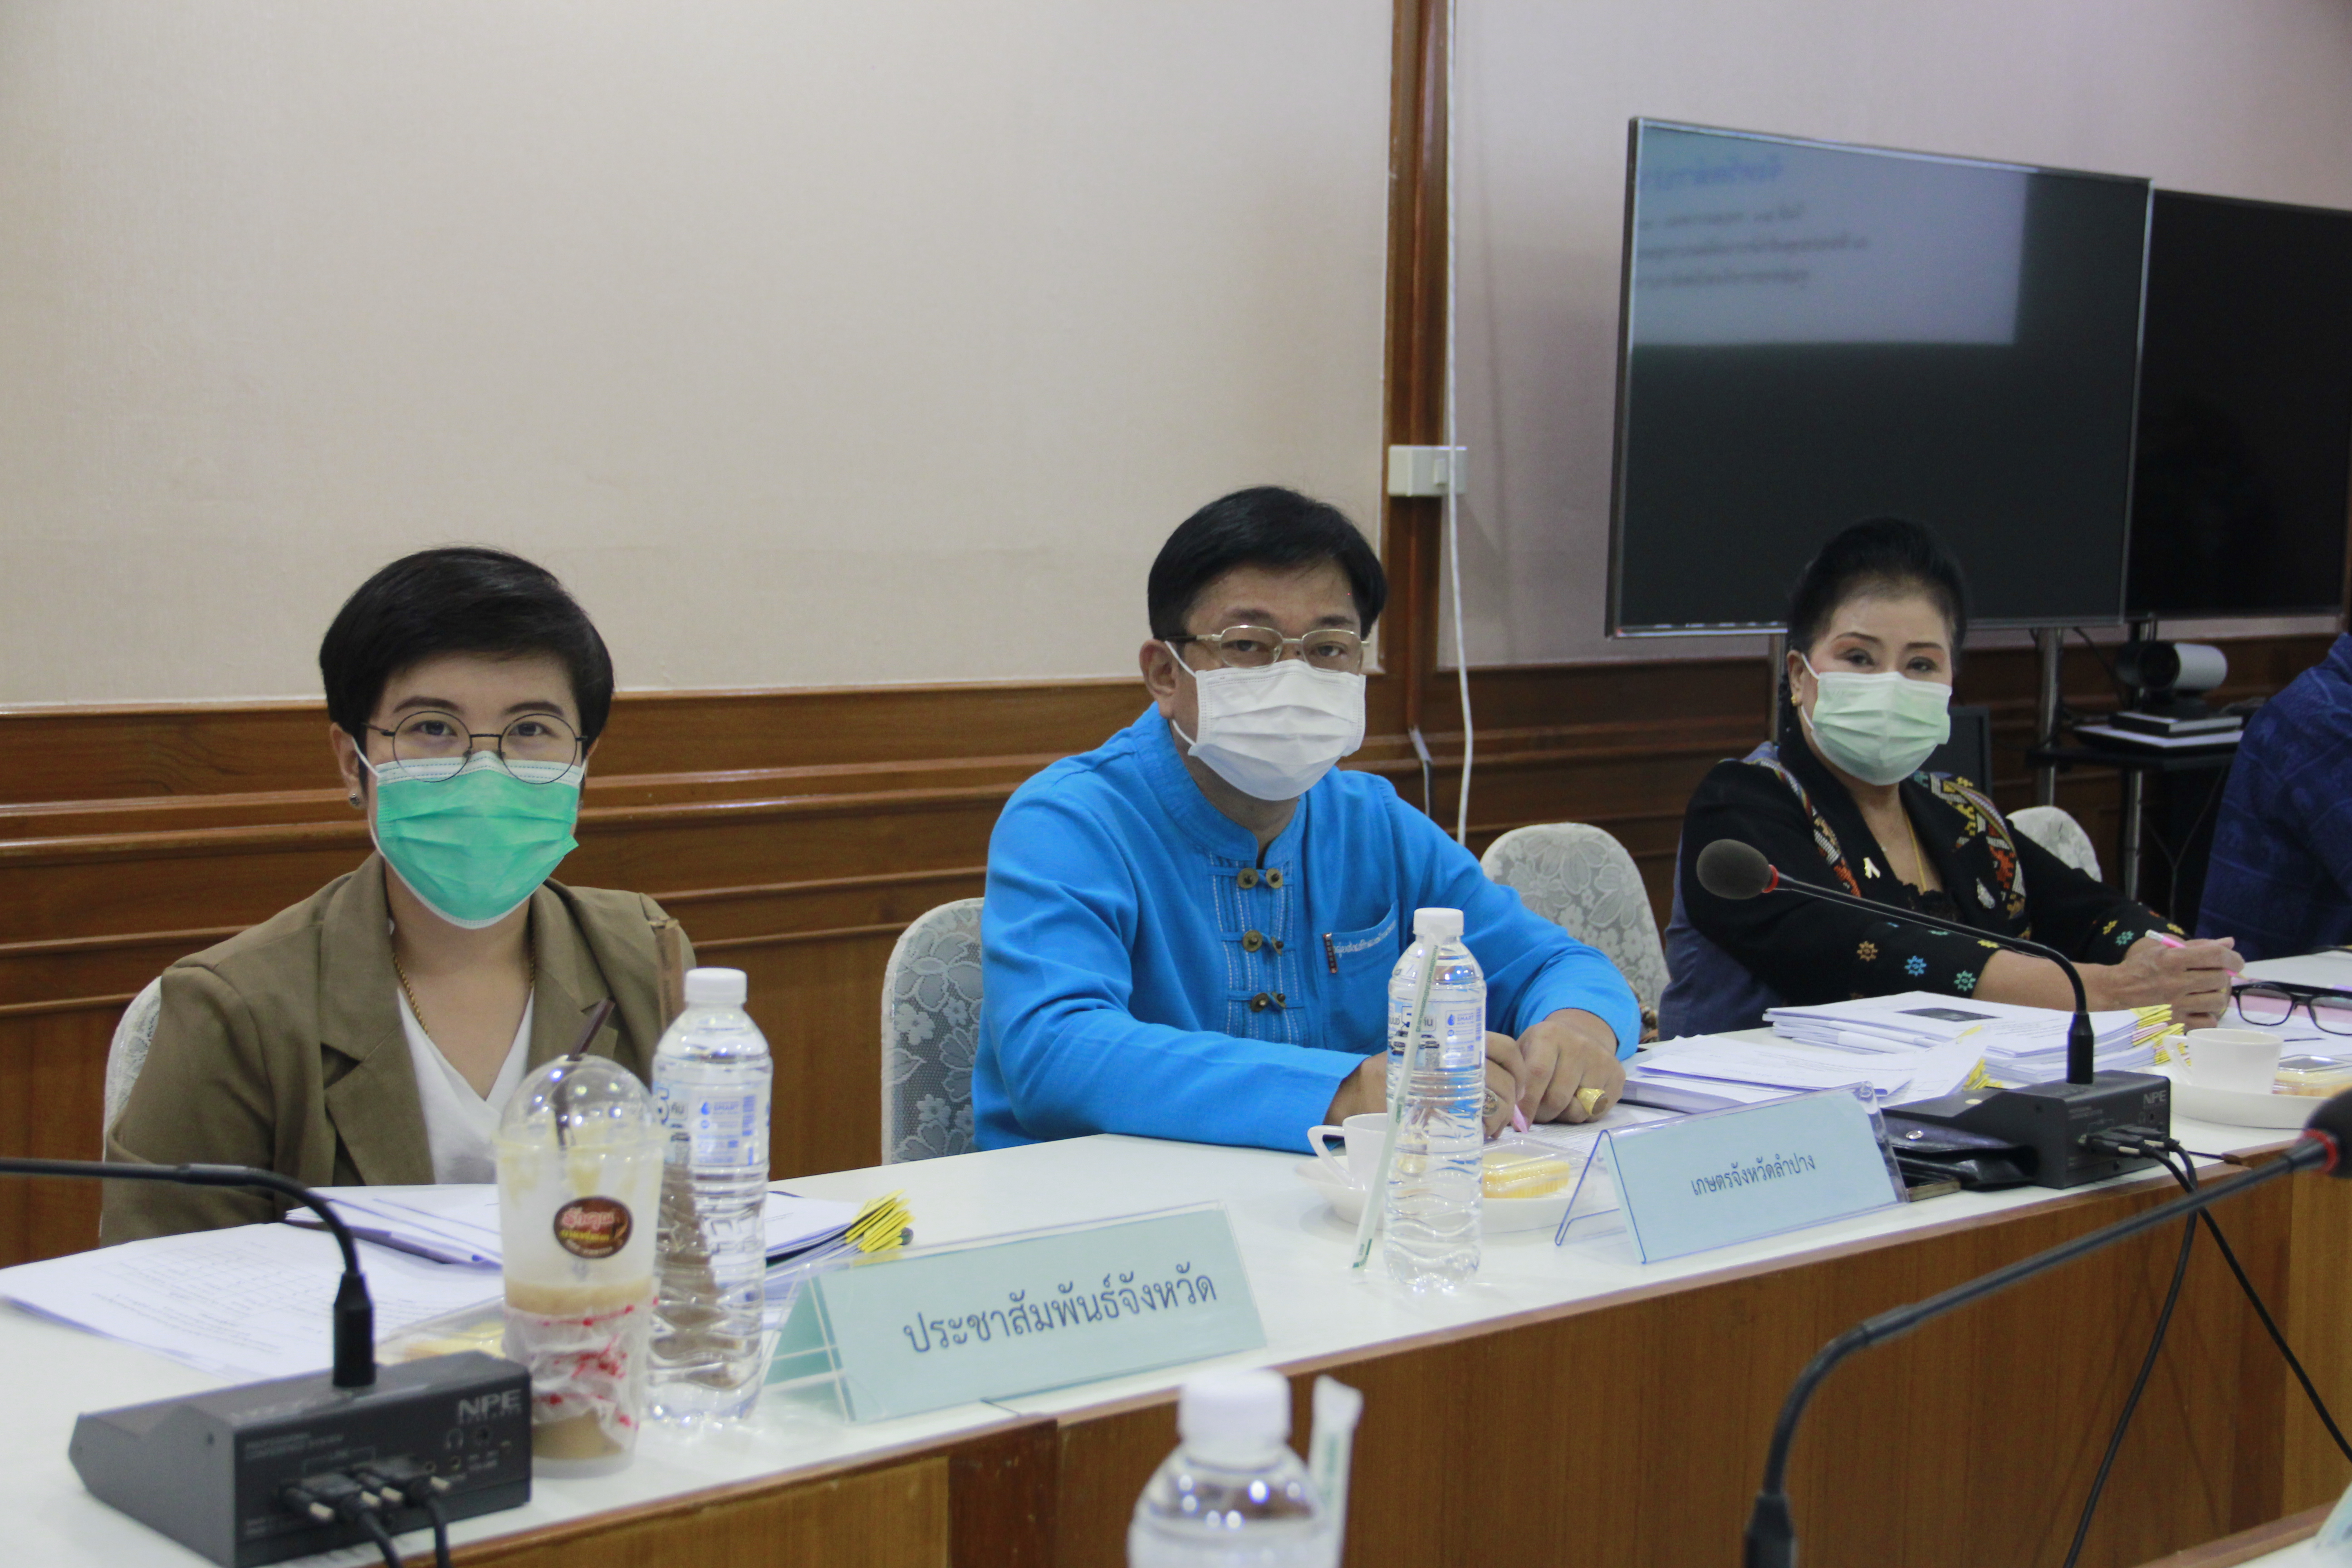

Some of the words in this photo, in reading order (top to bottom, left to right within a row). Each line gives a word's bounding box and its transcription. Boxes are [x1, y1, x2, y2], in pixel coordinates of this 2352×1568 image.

[2143, 1090, 2166, 1104] NPE
[1691, 1153, 1816, 1196] เกษตรจังหวัดลำปาง
[903, 1262, 1217, 1354] ประชาสัมพันธ์จังหวัด
[458, 1389, 521, 1416] NPE
